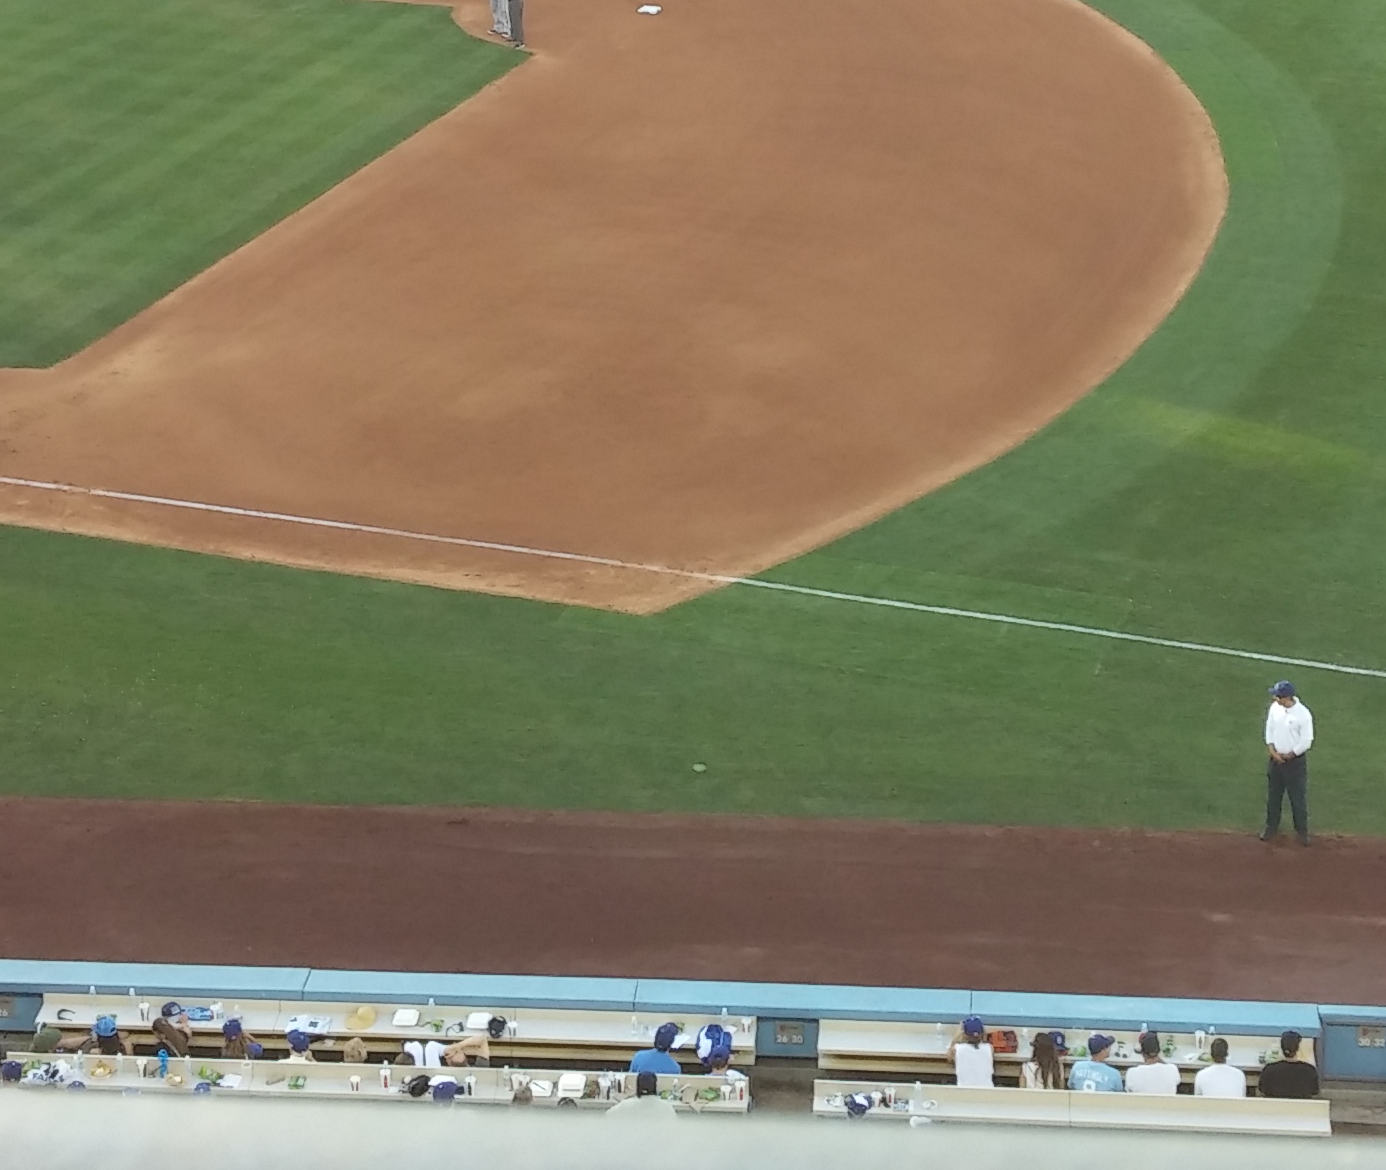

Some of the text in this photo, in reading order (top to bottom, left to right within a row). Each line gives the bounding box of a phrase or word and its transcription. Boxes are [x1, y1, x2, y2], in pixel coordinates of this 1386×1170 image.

[776, 1034, 788, 1044] 26
[1358, 1037, 1386, 1047] 30 32
